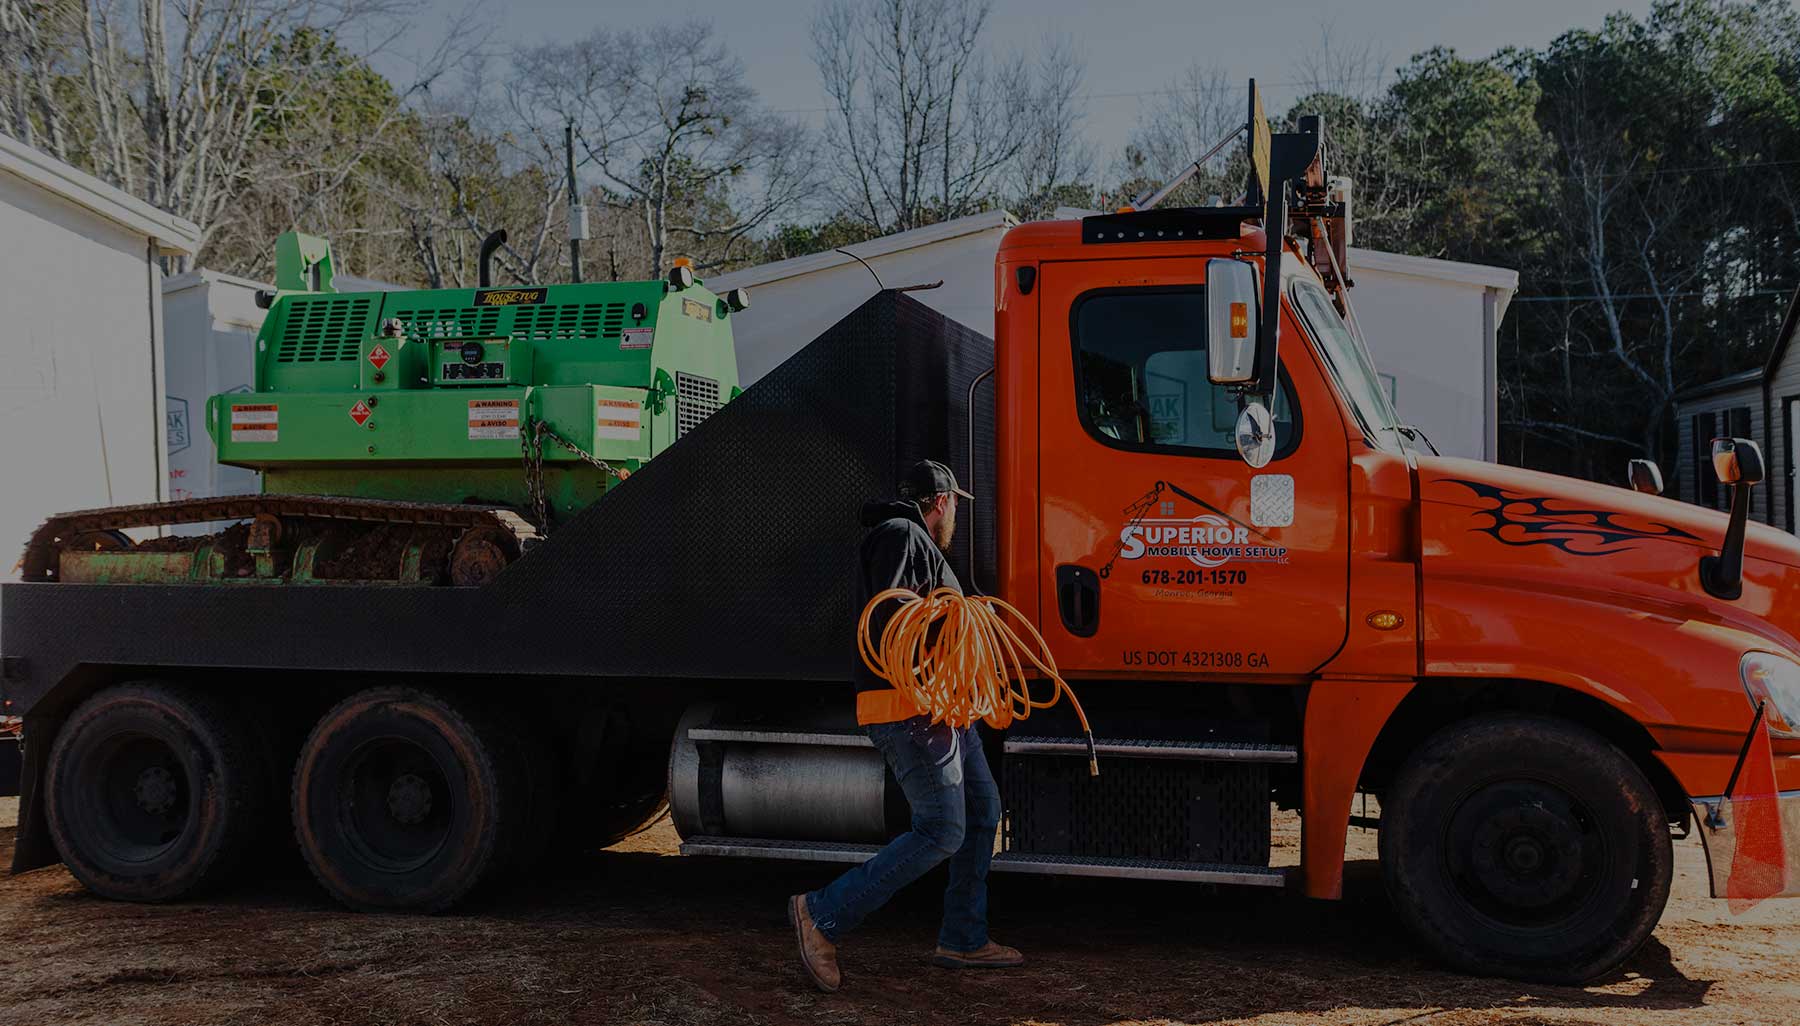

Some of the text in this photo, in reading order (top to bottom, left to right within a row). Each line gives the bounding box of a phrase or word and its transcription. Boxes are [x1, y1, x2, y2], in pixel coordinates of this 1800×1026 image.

[483, 291, 539, 304] HOUSE-TUG
[1120, 525, 1250, 559] SUPERIOR
[1148, 547, 1287, 557] MOBILE HOME SETUP
[1142, 569, 1247, 585] 678-201-1570
[1123, 651, 1270, 668] US DOT 4321308 GA
